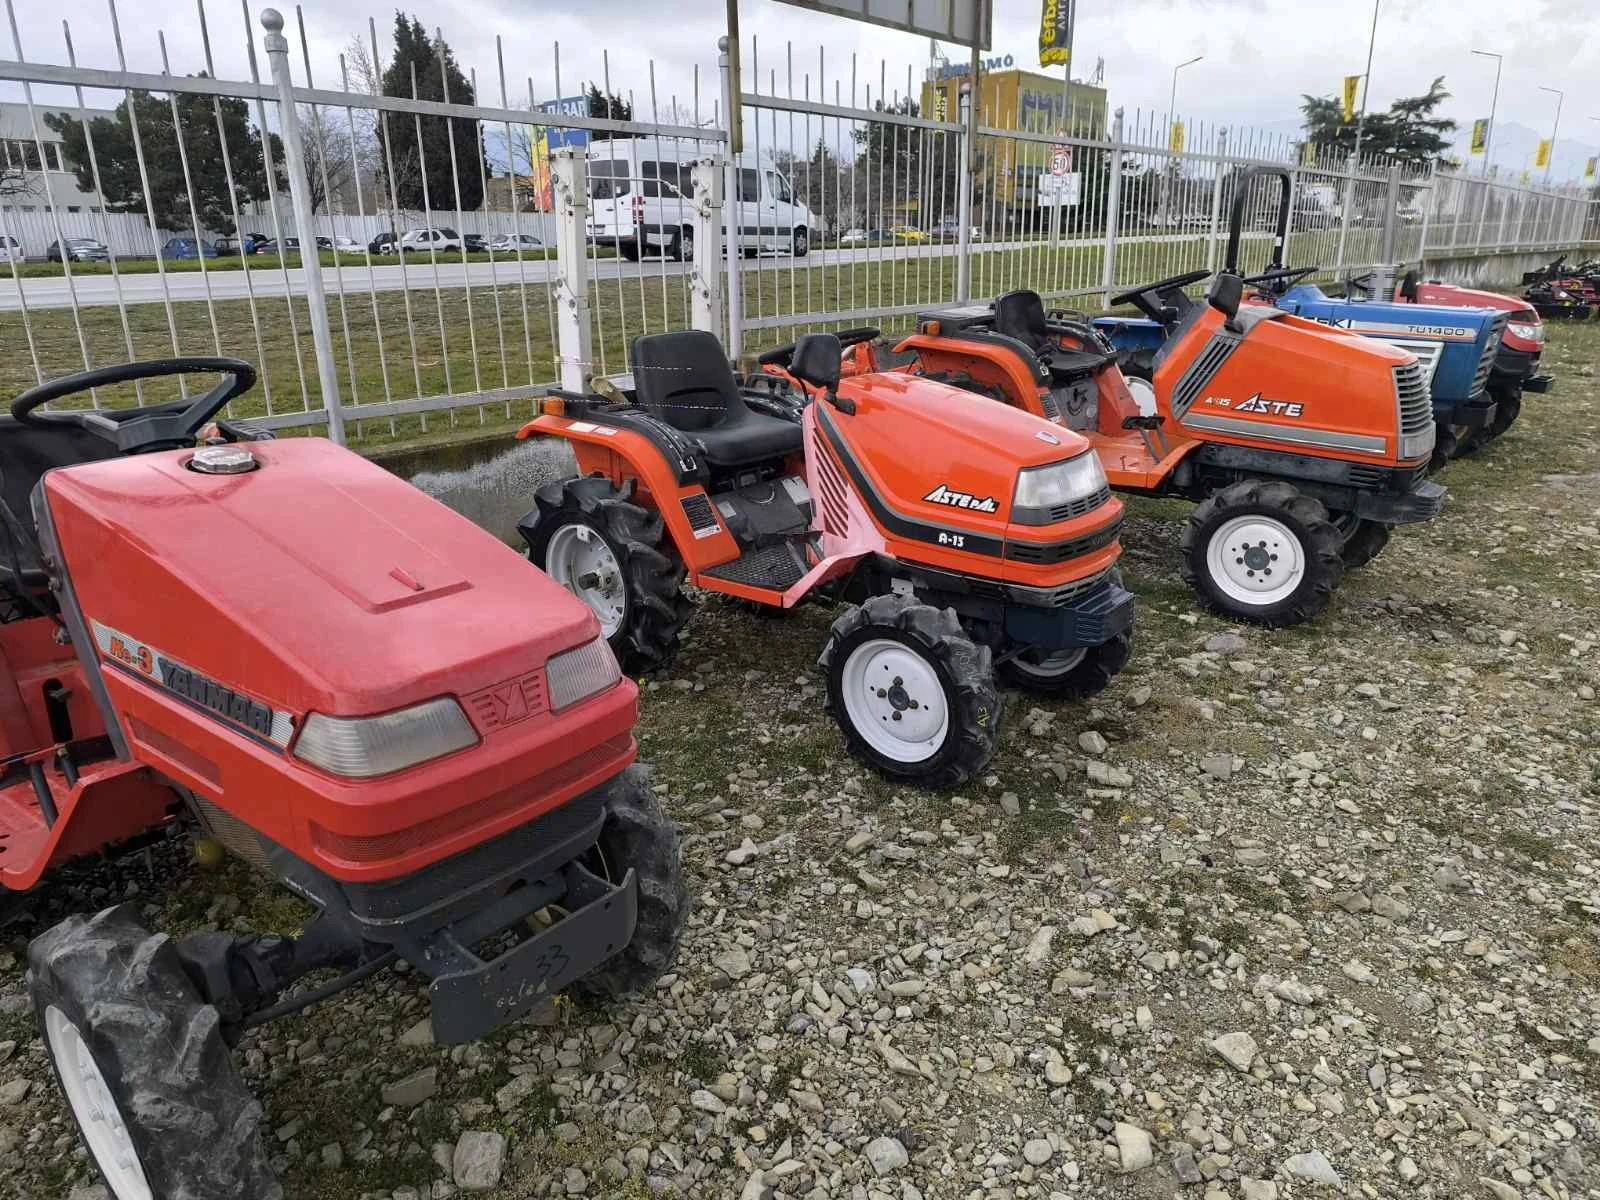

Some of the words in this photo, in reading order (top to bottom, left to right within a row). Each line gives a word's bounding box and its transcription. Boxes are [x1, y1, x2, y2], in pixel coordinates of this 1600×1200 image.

[1407, 324, 1466, 337] TU1400
[1233, 393, 1304, 417] ASTE
[157, 656, 273, 737] YANMAR
